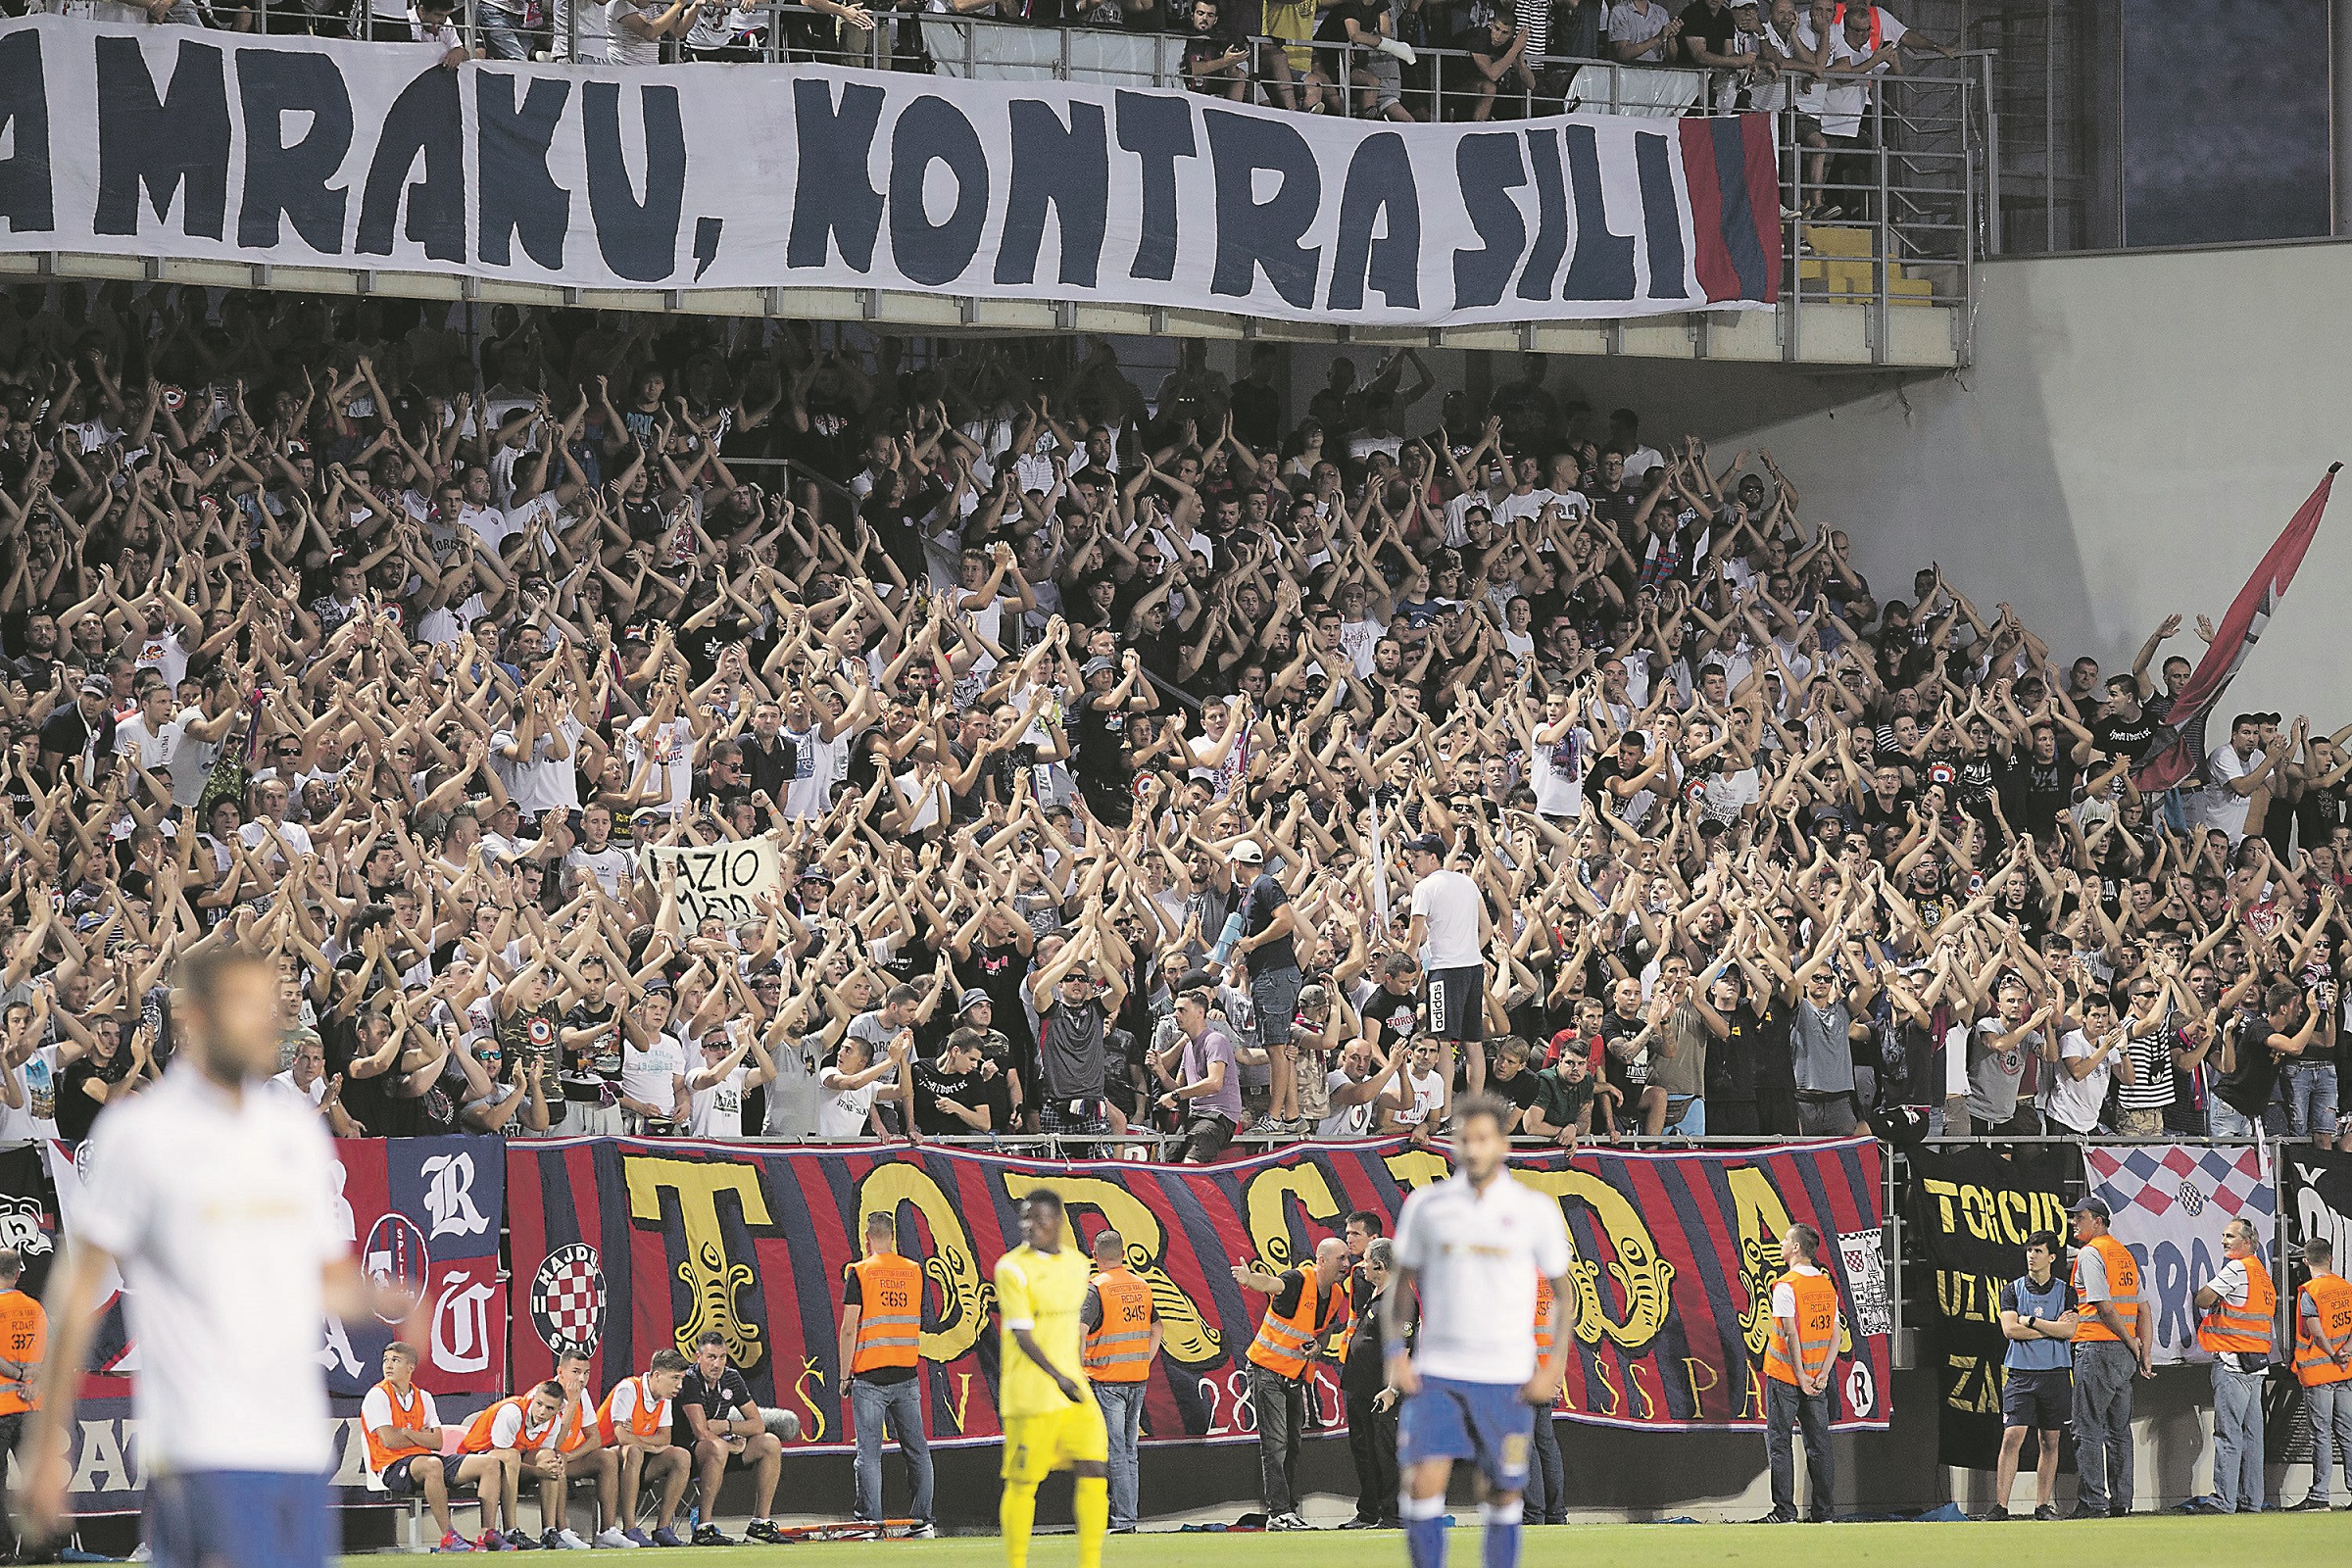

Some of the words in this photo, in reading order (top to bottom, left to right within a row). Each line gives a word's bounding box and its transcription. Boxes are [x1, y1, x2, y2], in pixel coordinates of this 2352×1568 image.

[94, 35, 723, 283] MRAKU,
[787, 77, 1420, 311] KONTRA
[1453, 123, 1690, 311] SILI
[1433, 983, 1444, 1029] adidas
[880, 1279, 906, 1290] REDAR
[880, 1291, 908, 1307] 369
[1121, 1294, 1144, 1304] REDAR
[1123, 1304, 1146, 1322] 345
[2331, 1310, 2352, 1329] 395
[1810, 1314, 1831, 1330] 433
